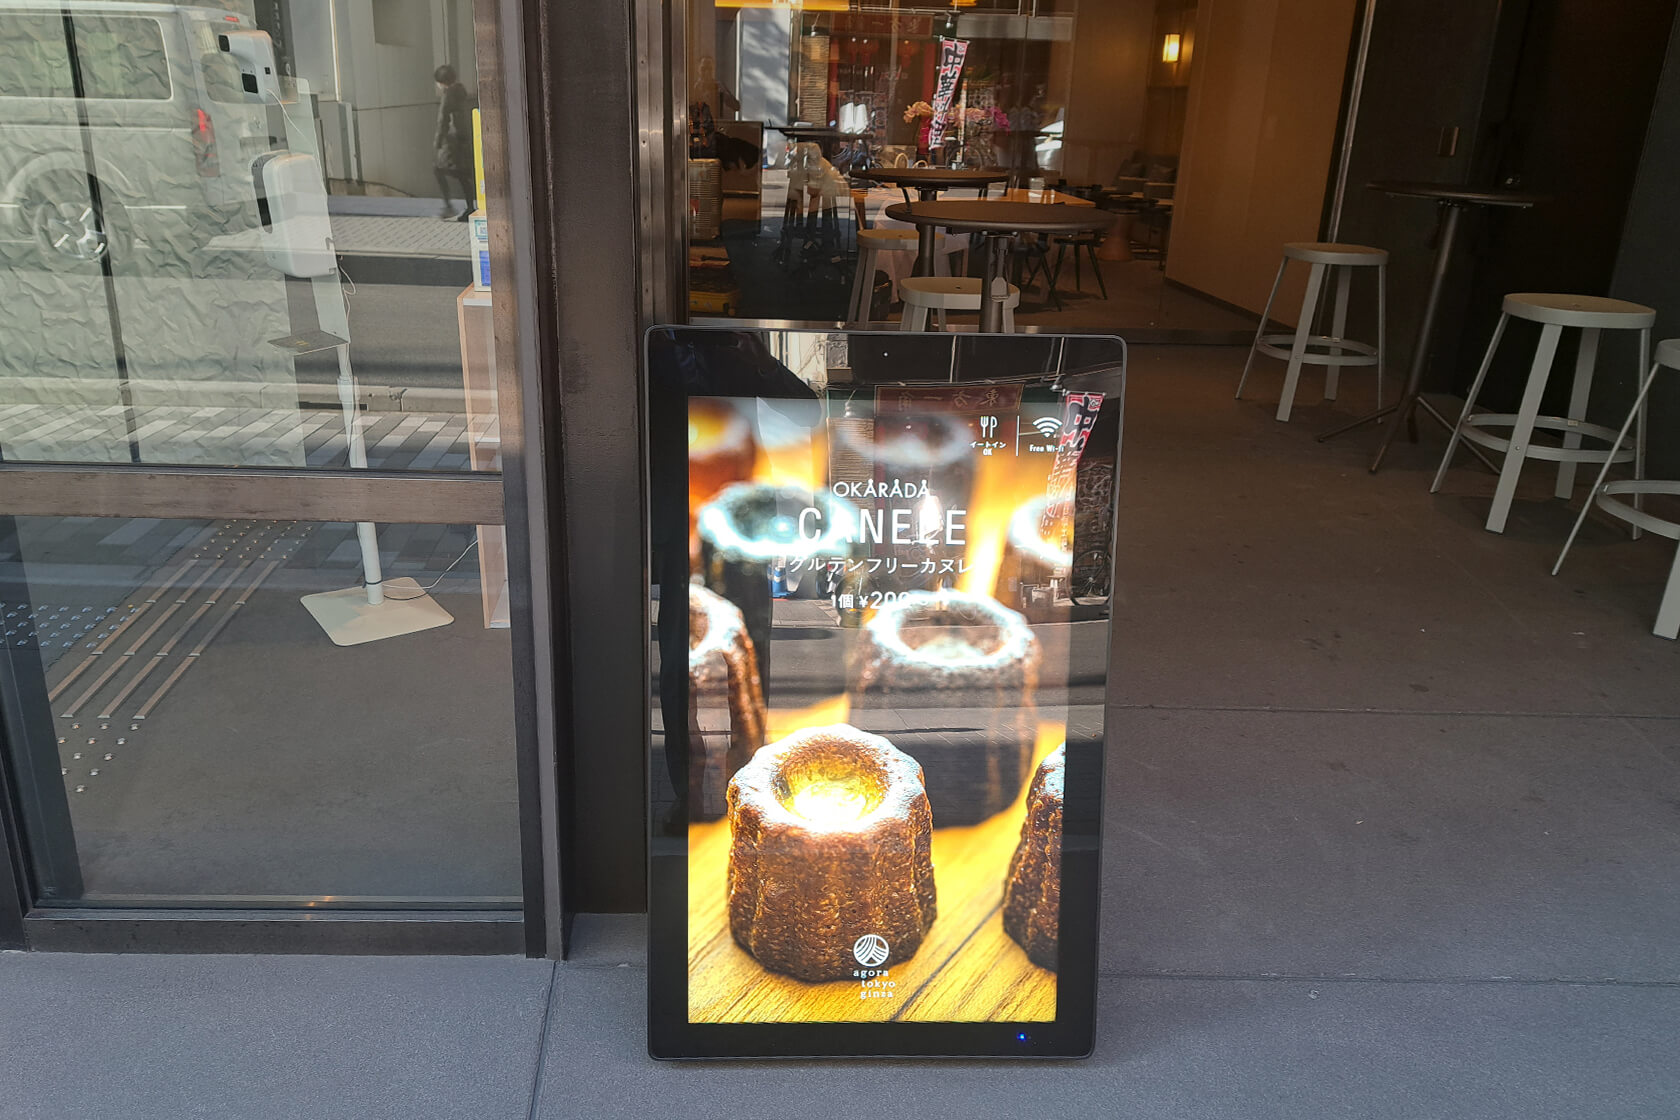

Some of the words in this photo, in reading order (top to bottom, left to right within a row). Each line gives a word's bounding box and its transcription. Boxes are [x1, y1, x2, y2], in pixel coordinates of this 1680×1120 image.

[969, 441, 1007, 449] イートイン
[1029, 444, 1044, 453] Free
[982, 448, 993, 456] OK
[798, 507, 967, 545] CNELE
[830, 594, 854, 609] 1個
[853, 970, 888, 979] agora
[861, 980, 895, 990] tokyo
[860, 990, 893, 999] ginza
